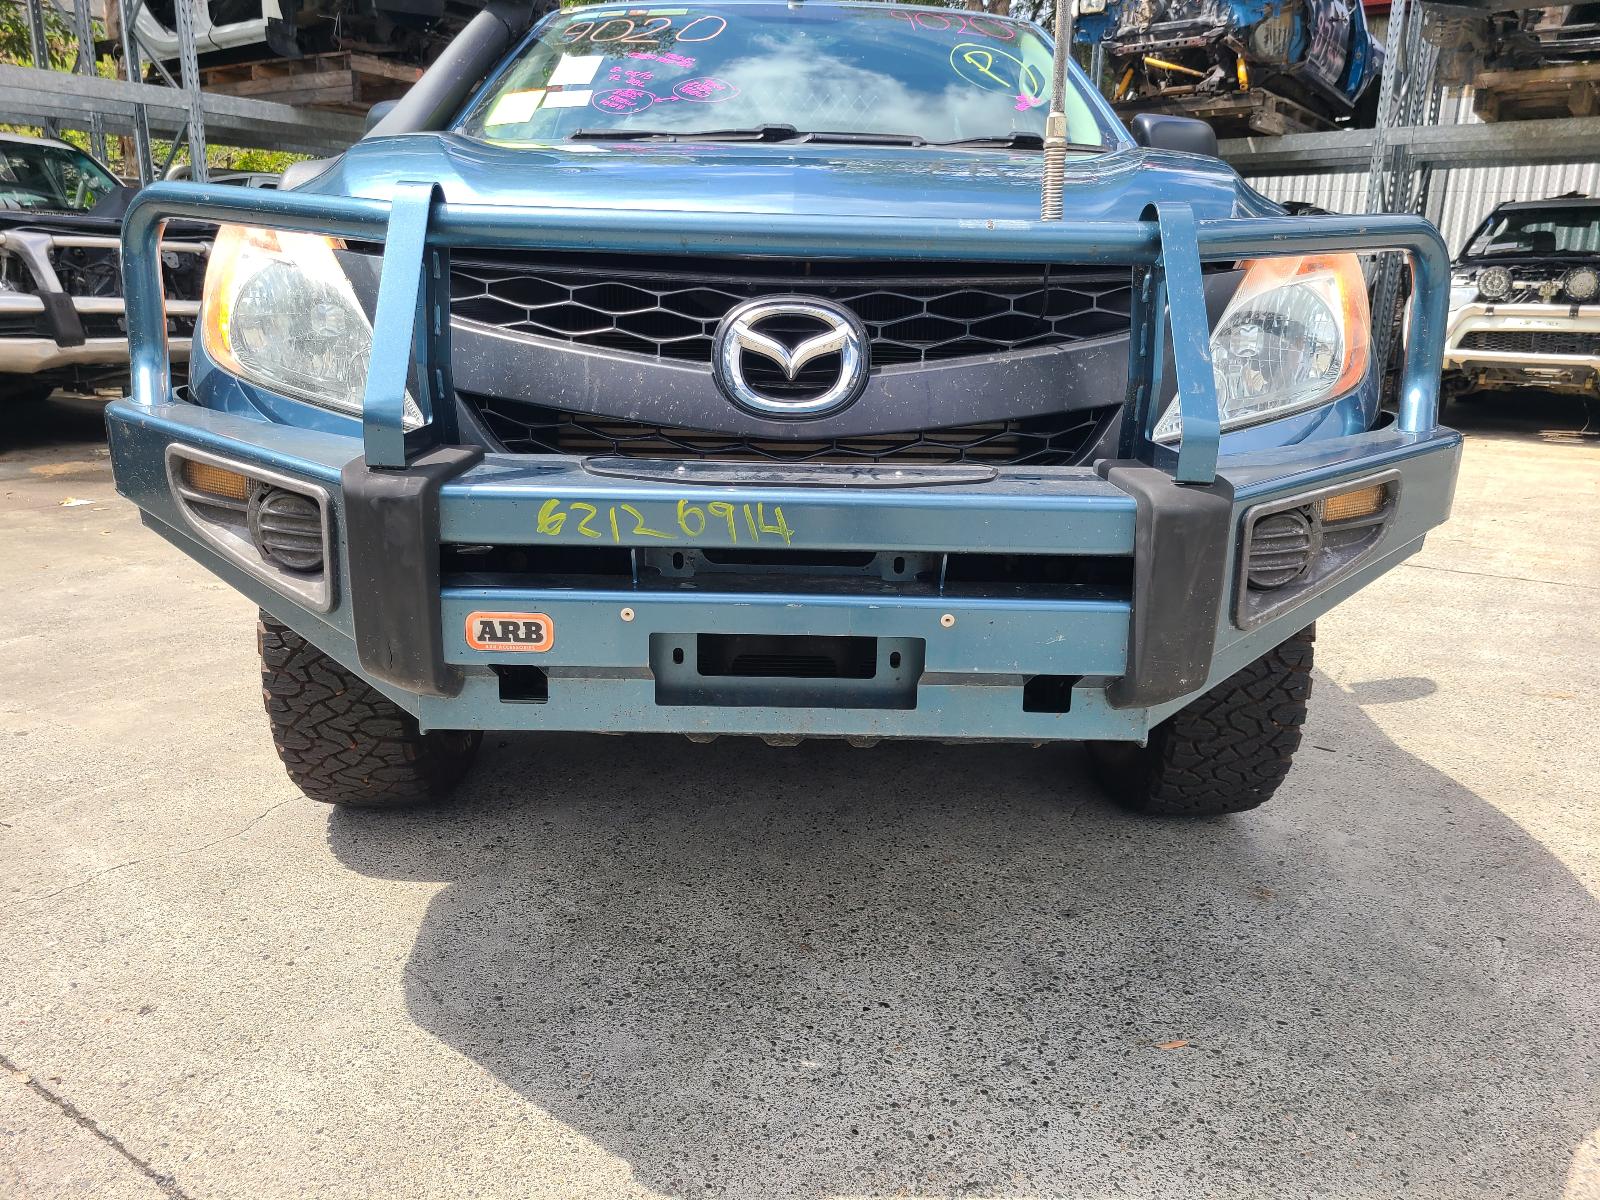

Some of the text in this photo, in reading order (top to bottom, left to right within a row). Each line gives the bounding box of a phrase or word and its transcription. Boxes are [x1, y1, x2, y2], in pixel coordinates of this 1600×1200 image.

[563, 16, 727, 43] 9020
[890, 10, 1016, 40] 9020
[537, 499, 794, 546] 6212 6914
[477, 621, 544, 643] ARB
